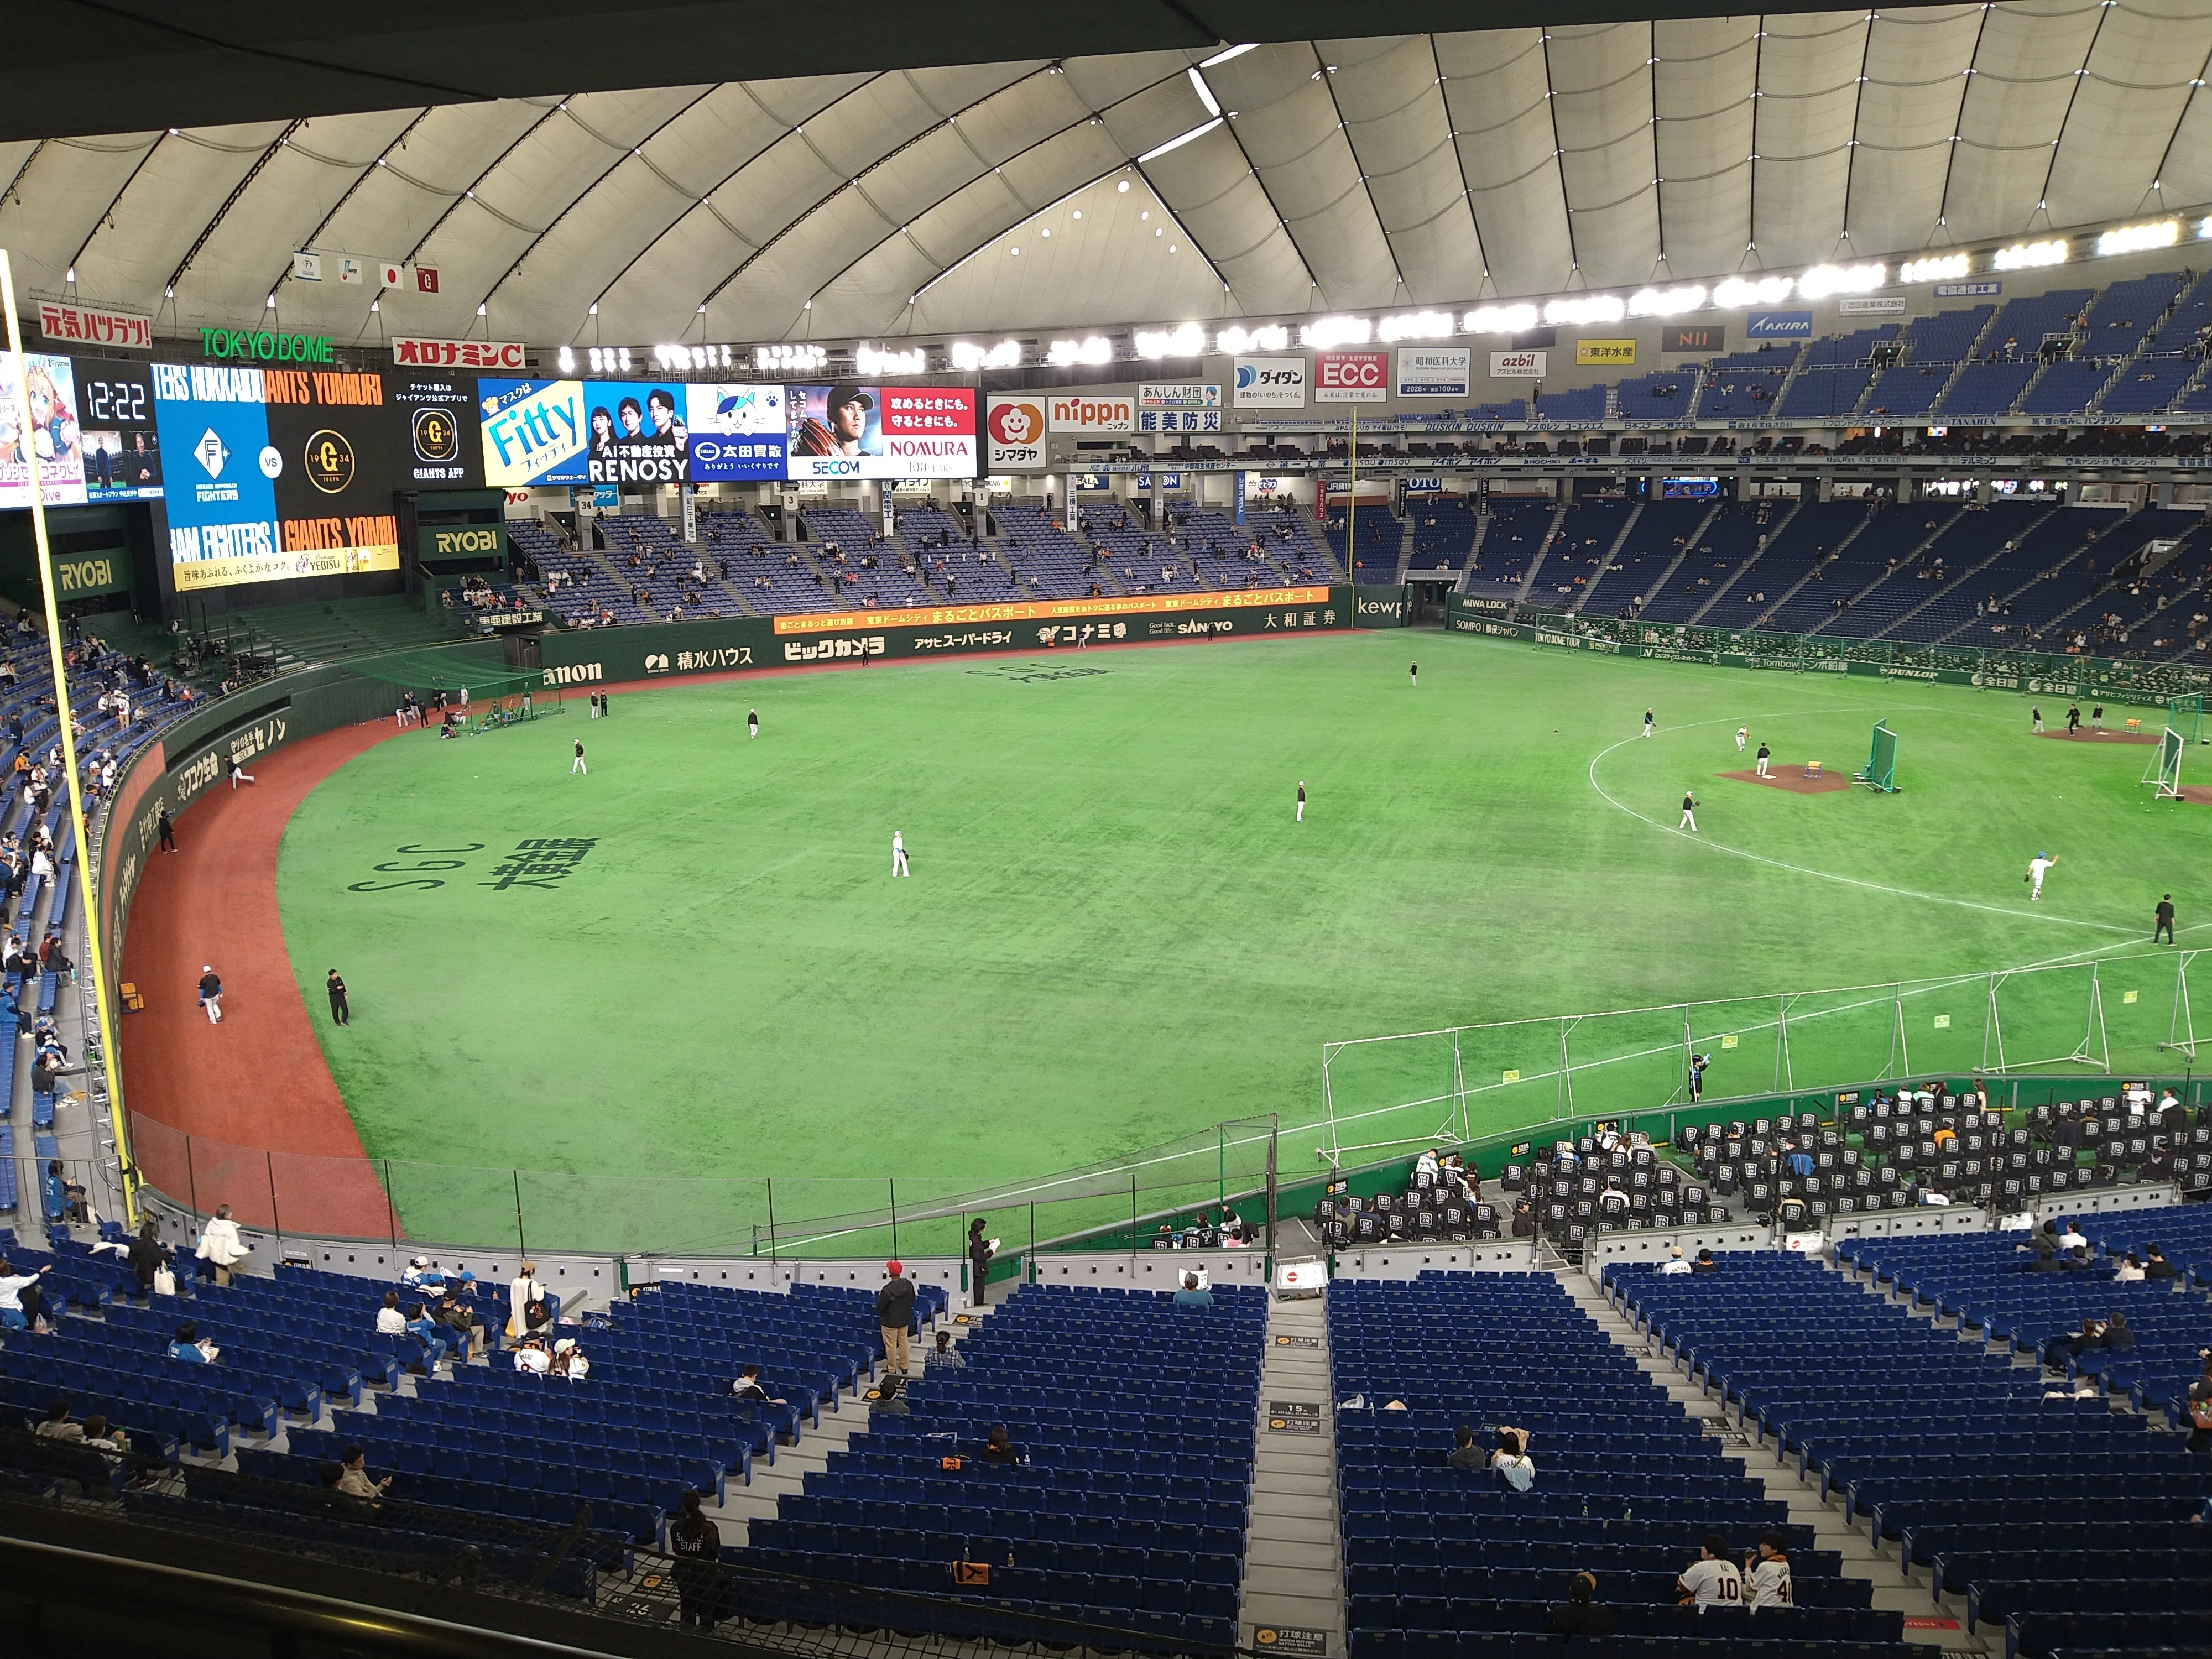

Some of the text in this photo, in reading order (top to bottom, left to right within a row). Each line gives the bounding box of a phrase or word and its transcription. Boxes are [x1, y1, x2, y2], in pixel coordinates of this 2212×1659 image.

[1765, 322, 1809, 331] AKIRA
[199, 328, 334, 363] TOKYO DOME
[1679, 332, 1707, 346] NII
[397, 341, 522, 367] オロナミンC
[1590, 347, 1633, 357] 東洋水産
[1416, 356, 1466, 366] 昭和医科大学
[1502, 354, 1535, 367] azbil
[1260, 369, 1302, 385] ダイダン
[1323, 363, 1379, 385] ECC
[312, 372, 383, 405] YOMIURI
[499, 383, 532, 405] マスクは
[1144, 387, 1201, 399] あんしん財団
[87, 382, 147, 420] 12:22
[396, 394, 468, 402] ジャイアンツ公式アプリで
[890, 397, 968, 410] 攻めるときにも。
[1055, 398, 1129, 425] nippn
[891, 415, 958, 427] 守るときにも。
[1141, 411, 1218, 431] 能美防災
[489, 397, 577, 468] Fitty
[602, 445, 675, 458] AI不動産投資
[723, 445, 782, 458] 太田胃散
[891, 441, 968, 456] NOMURA
[995, 447, 1037, 461] シマダヤ
[265, 458, 277, 467] VS
[521, 443, 566, 473] フィッティ
[413, 468, 464, 479] GIANTS APP
[589, 459, 688, 482] RENOSY
[813, 461, 859, 474] SECOM
[1408, 478, 1441, 488] OTO
[196, 489, 238, 502] FIGHTERS
[581, 501, 591, 510] 34
[883, 491, 893, 519] 関電工
[202, 521, 272, 560] FIGHTERS
[284, 517, 343, 552] GIANTS
[436, 530, 497, 553] RYOBI
[184, 561, 290, 582] 旨味あふれる、ふくよかなコク。
[310, 560, 340, 572] YEBISU
[59, 559, 112, 591] RYOBI
[780, 617, 853, 630] 街ごとまるっと遊び放題
[867, 614, 927, 625] 東京ドームシティ
[932, 606, 1036, 623] まるごとパスポート
[1165, 598, 1218, 608] 東京ドームシティ
[1222, 590, 1314, 606] まるごとパスポート
[1463, 599, 1508, 609] MIWA LOCK
[479, 611, 544, 626] 東亜建設工業
[1264, 609, 1337, 629] 大和証券
[1456, 620, 1481, 632] SOMPO
[1063, 623, 1110, 642] コナミ
[1486, 624, 1519, 637] 損保ジャパン
[914, 630, 1013, 649] アサヒスーパードライ
[1535, 632, 1580, 647] TOKYO DOME TOUR
[785, 636, 885, 661] ビックカメラ
[677, 647, 753, 671] 積水ハウス
[1762, 658, 1798, 668] Tombow
[1802, 660, 1848, 671] トンボ鉛筆
[542, 662, 602, 686] anon
[1888, 668, 1938, 679] DUNLOP
[1985, 676, 2018, 688] 全日警
[2043, 682, 2077, 695] 全日警
[254, 718, 286, 751] セノン
[185, 750, 219, 796] フコク生命
[680, 1542, 702, 1552] STAFF
[1718, 1577, 1738, 1600] 10
[1279, 1629, 1323, 1641] 打球注意
